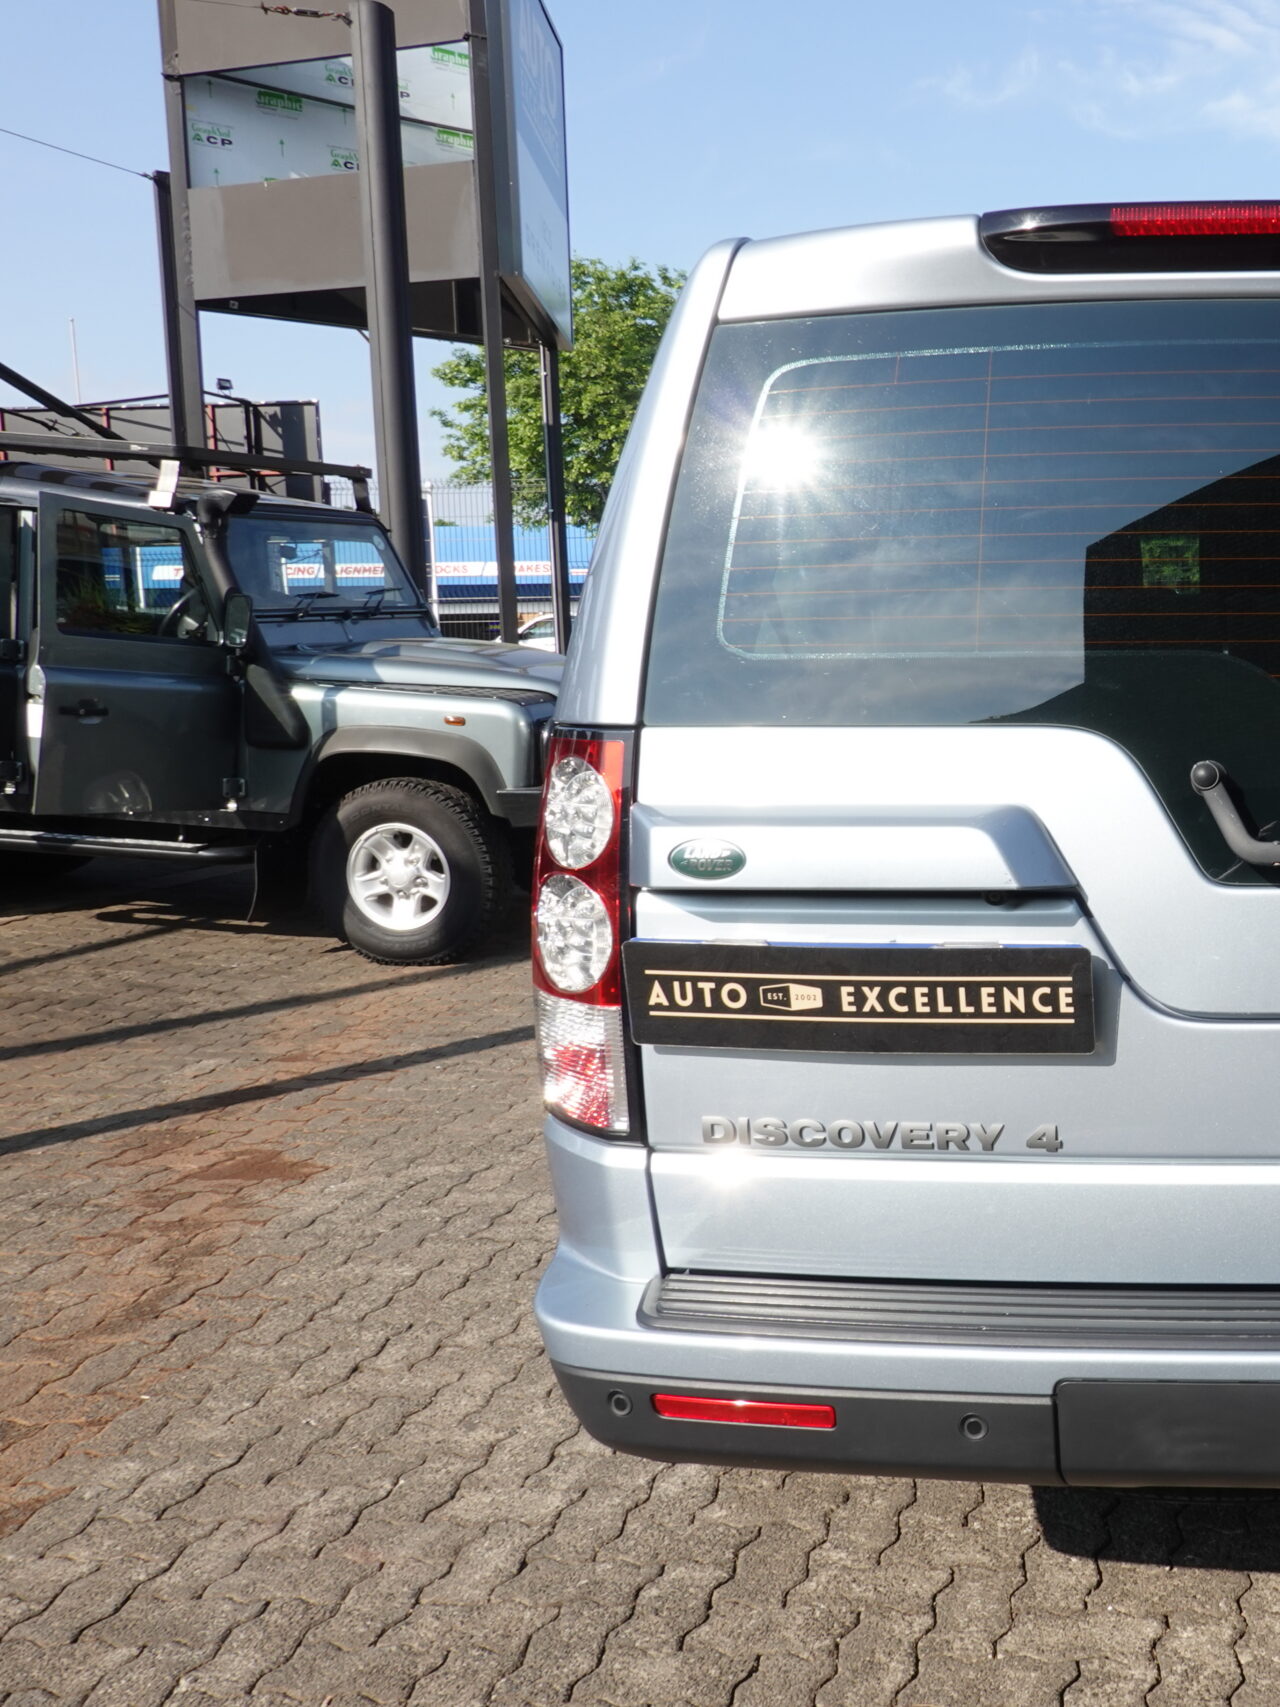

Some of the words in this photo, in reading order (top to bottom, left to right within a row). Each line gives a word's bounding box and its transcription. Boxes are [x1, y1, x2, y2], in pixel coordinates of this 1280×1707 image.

[325, 74, 354, 87] AC
[192, 133, 233, 146] ACP
[331, 158, 360, 171] AC
[688, 858, 734, 872] ROVER
[648, 980, 748, 1010] AUTO
[767, 992, 787, 1001] EST.
[794, 993, 817, 1001] 2002
[841, 985, 1076, 1014] EXCELLENCE
[701, 1115, 1006, 1152] DISCOVERY
[1026, 1123, 1064, 1153] 4
